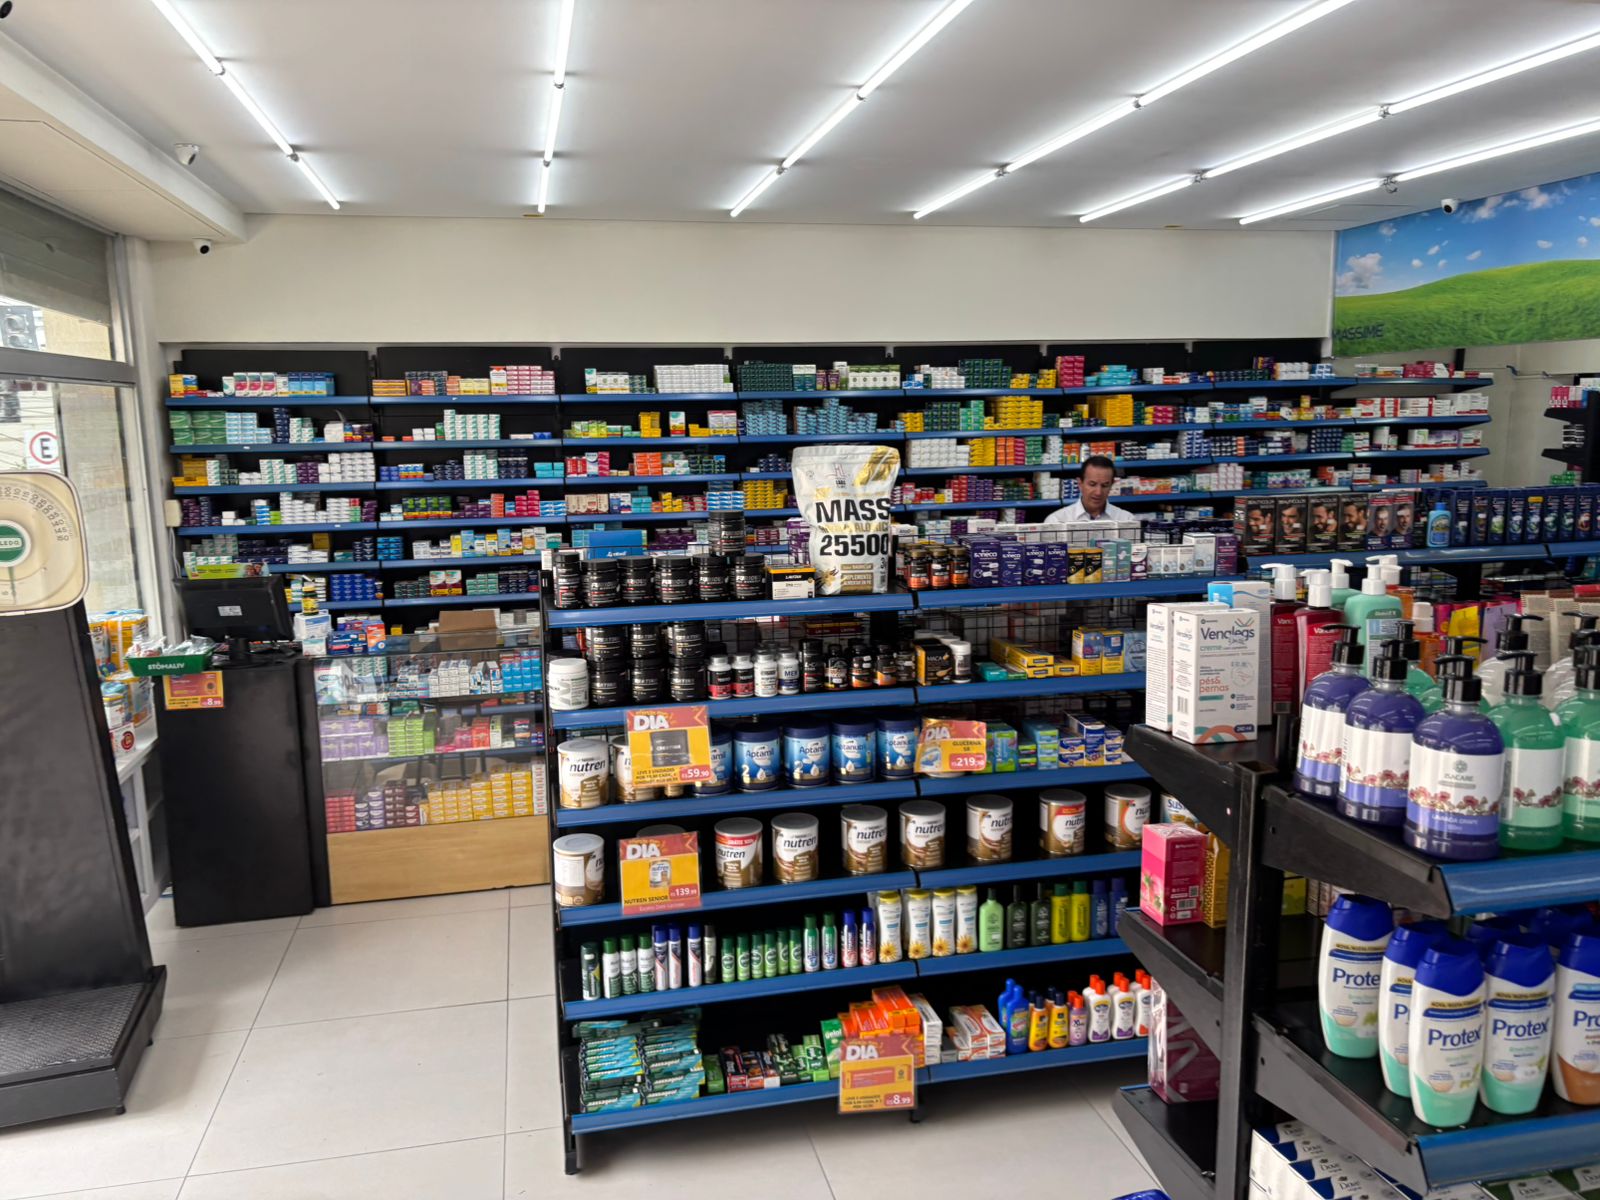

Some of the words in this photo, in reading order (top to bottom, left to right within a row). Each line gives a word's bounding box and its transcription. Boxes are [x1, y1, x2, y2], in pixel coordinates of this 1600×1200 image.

[40, 438, 52, 458] E
[816, 498, 890, 523] MASS
[820, 533, 888, 557] 25500
[633, 714, 670, 731] DIA
[926, 728, 951, 740] DIA
[569, 759, 606, 773] nutren
[856, 829, 886, 841] nutre
[914, 822, 944, 835] nutre
[783, 835, 817, 848] nutren
[626, 843, 660, 860] DIA
[717, 849, 746, 858] nutren
[1333, 967, 1380, 987] Prote
[1573, 1010, 1600, 1027] Pro
[1427, 1023, 1483, 1048] Protex
[1492, 1017, 1550, 1038] Protex
[845, 1044, 879, 1061] DIA
